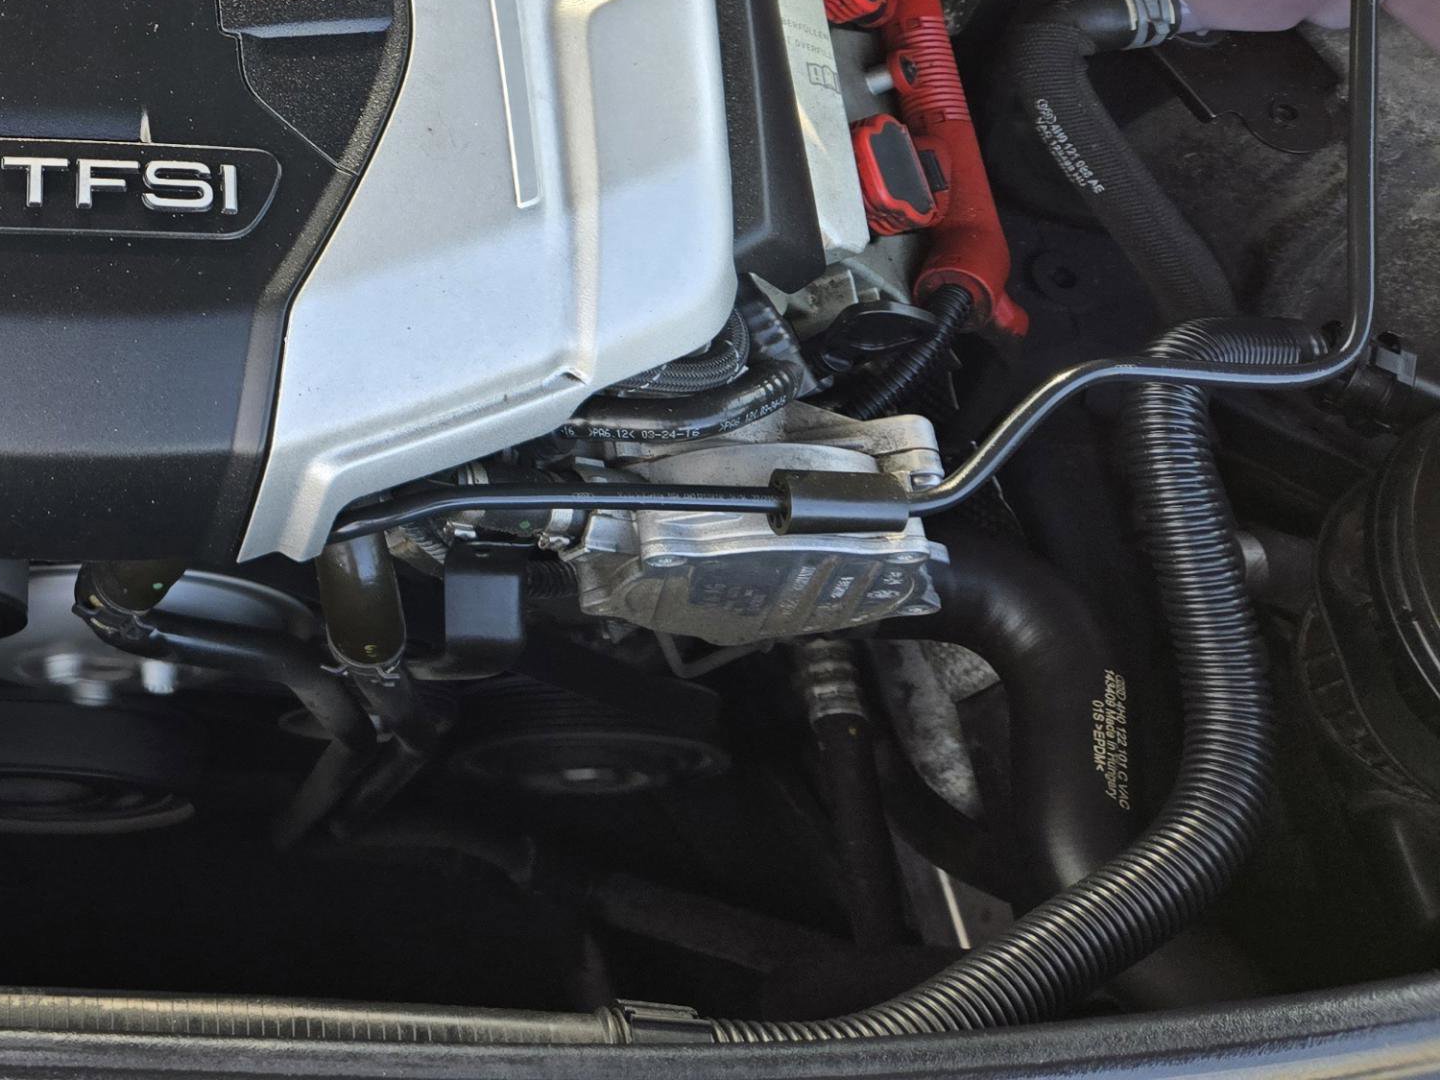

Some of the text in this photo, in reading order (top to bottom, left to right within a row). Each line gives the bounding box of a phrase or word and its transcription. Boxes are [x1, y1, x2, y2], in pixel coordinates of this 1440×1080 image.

[1, 155, 240, 215] TFSI
[1105, 708, 1117, 739] Made
[1116, 729, 1128, 747] 122
[1117, 750, 1128, 769] 101
[1105, 751, 1118, 800] Hungary
